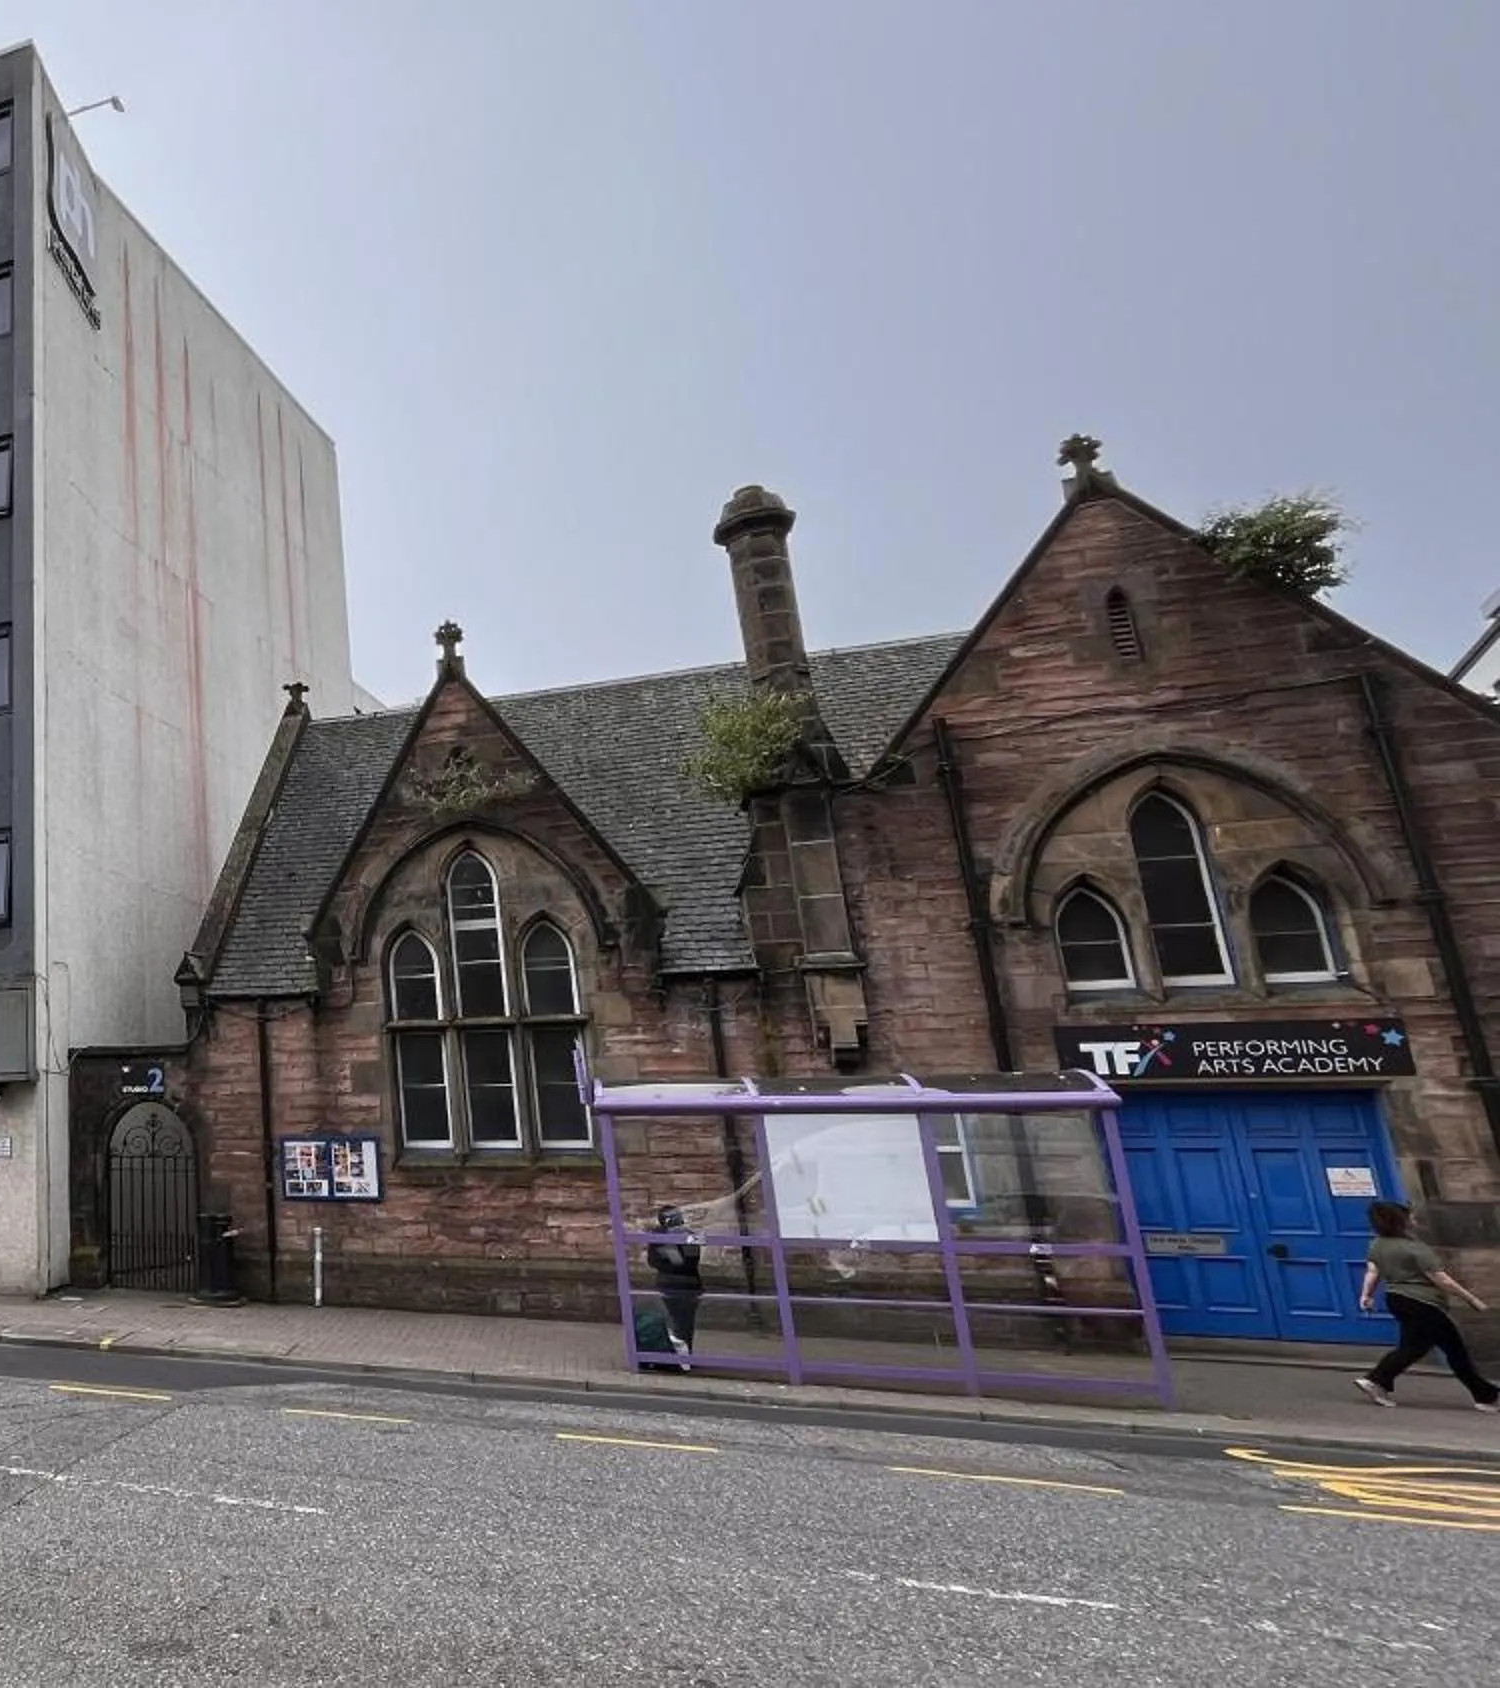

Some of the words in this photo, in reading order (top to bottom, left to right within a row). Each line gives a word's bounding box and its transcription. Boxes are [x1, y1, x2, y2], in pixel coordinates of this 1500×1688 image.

[1192, 1039, 1348, 1057] PERFORMING
[1197, 1058, 1255, 1074] ARTS
[1262, 1056, 1383, 1074] ACADEMY
[147, 1067, 164, 1092] 2
